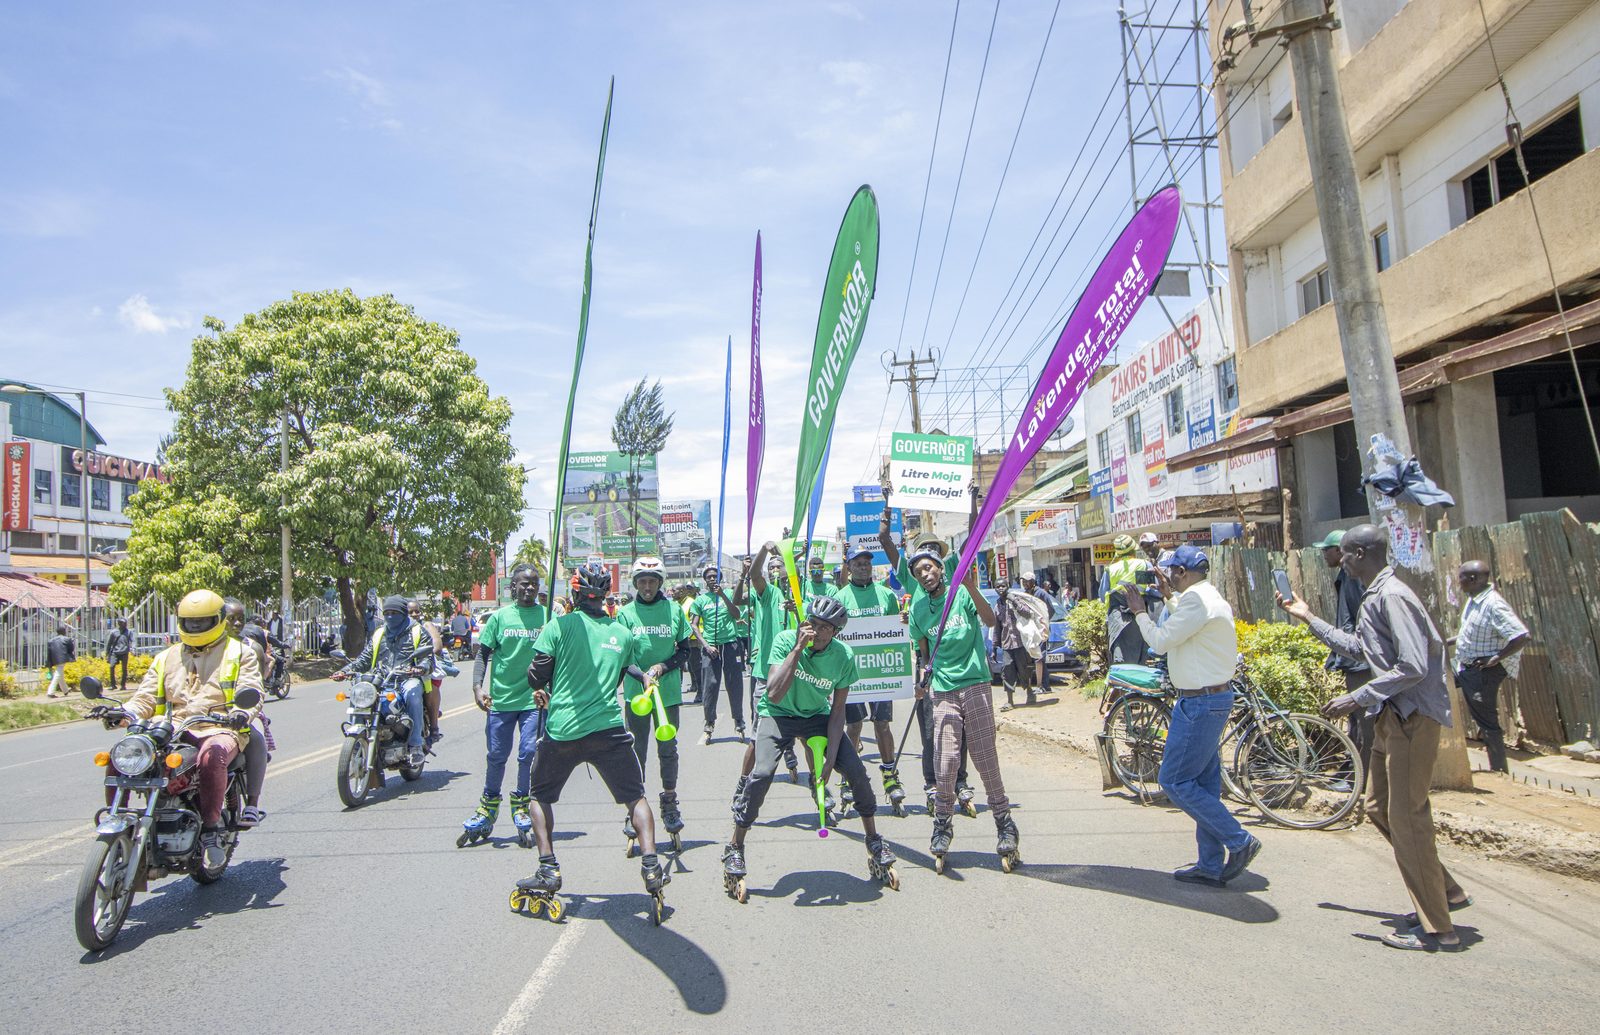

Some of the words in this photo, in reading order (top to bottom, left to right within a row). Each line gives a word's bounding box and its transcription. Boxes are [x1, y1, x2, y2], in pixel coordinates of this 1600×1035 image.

[1105, 279, 1149, 349] Fertilizer
[808, 260, 866, 428] GOVERNOR
[1017, 328, 1091, 452] Lavender
[1094, 254, 1141, 324] Total
[1111, 354, 1147, 403] ZAKIRS
[1151, 314, 1201, 376] LIMITED
[1176, 353, 1199, 380] Sanitay
[895, 439, 966, 457] GOVERNOR
[1191, 431, 1214, 449] deluxe
[568, 455, 607, 464] OVERNOR
[901, 469, 930, 479] Litre
[931, 471, 962, 483] Moja
[10, 461, 21, 528] QUICKMART
[899, 485, 927, 495] Acre
[929, 487, 963, 498] Moja!
[661, 503, 691, 511] Hotpoint
[1114, 508, 1135, 530] APPLE
[1160, 532, 1180, 541] APPLE
[1186, 531, 1211, 540] BOOKSH
[850, 605, 885, 616] GOVERNOR
[504, 628, 539, 638] GOVERNO
[632, 625, 672, 635] GOVERNOR
[874, 628, 904, 638] Hodari
